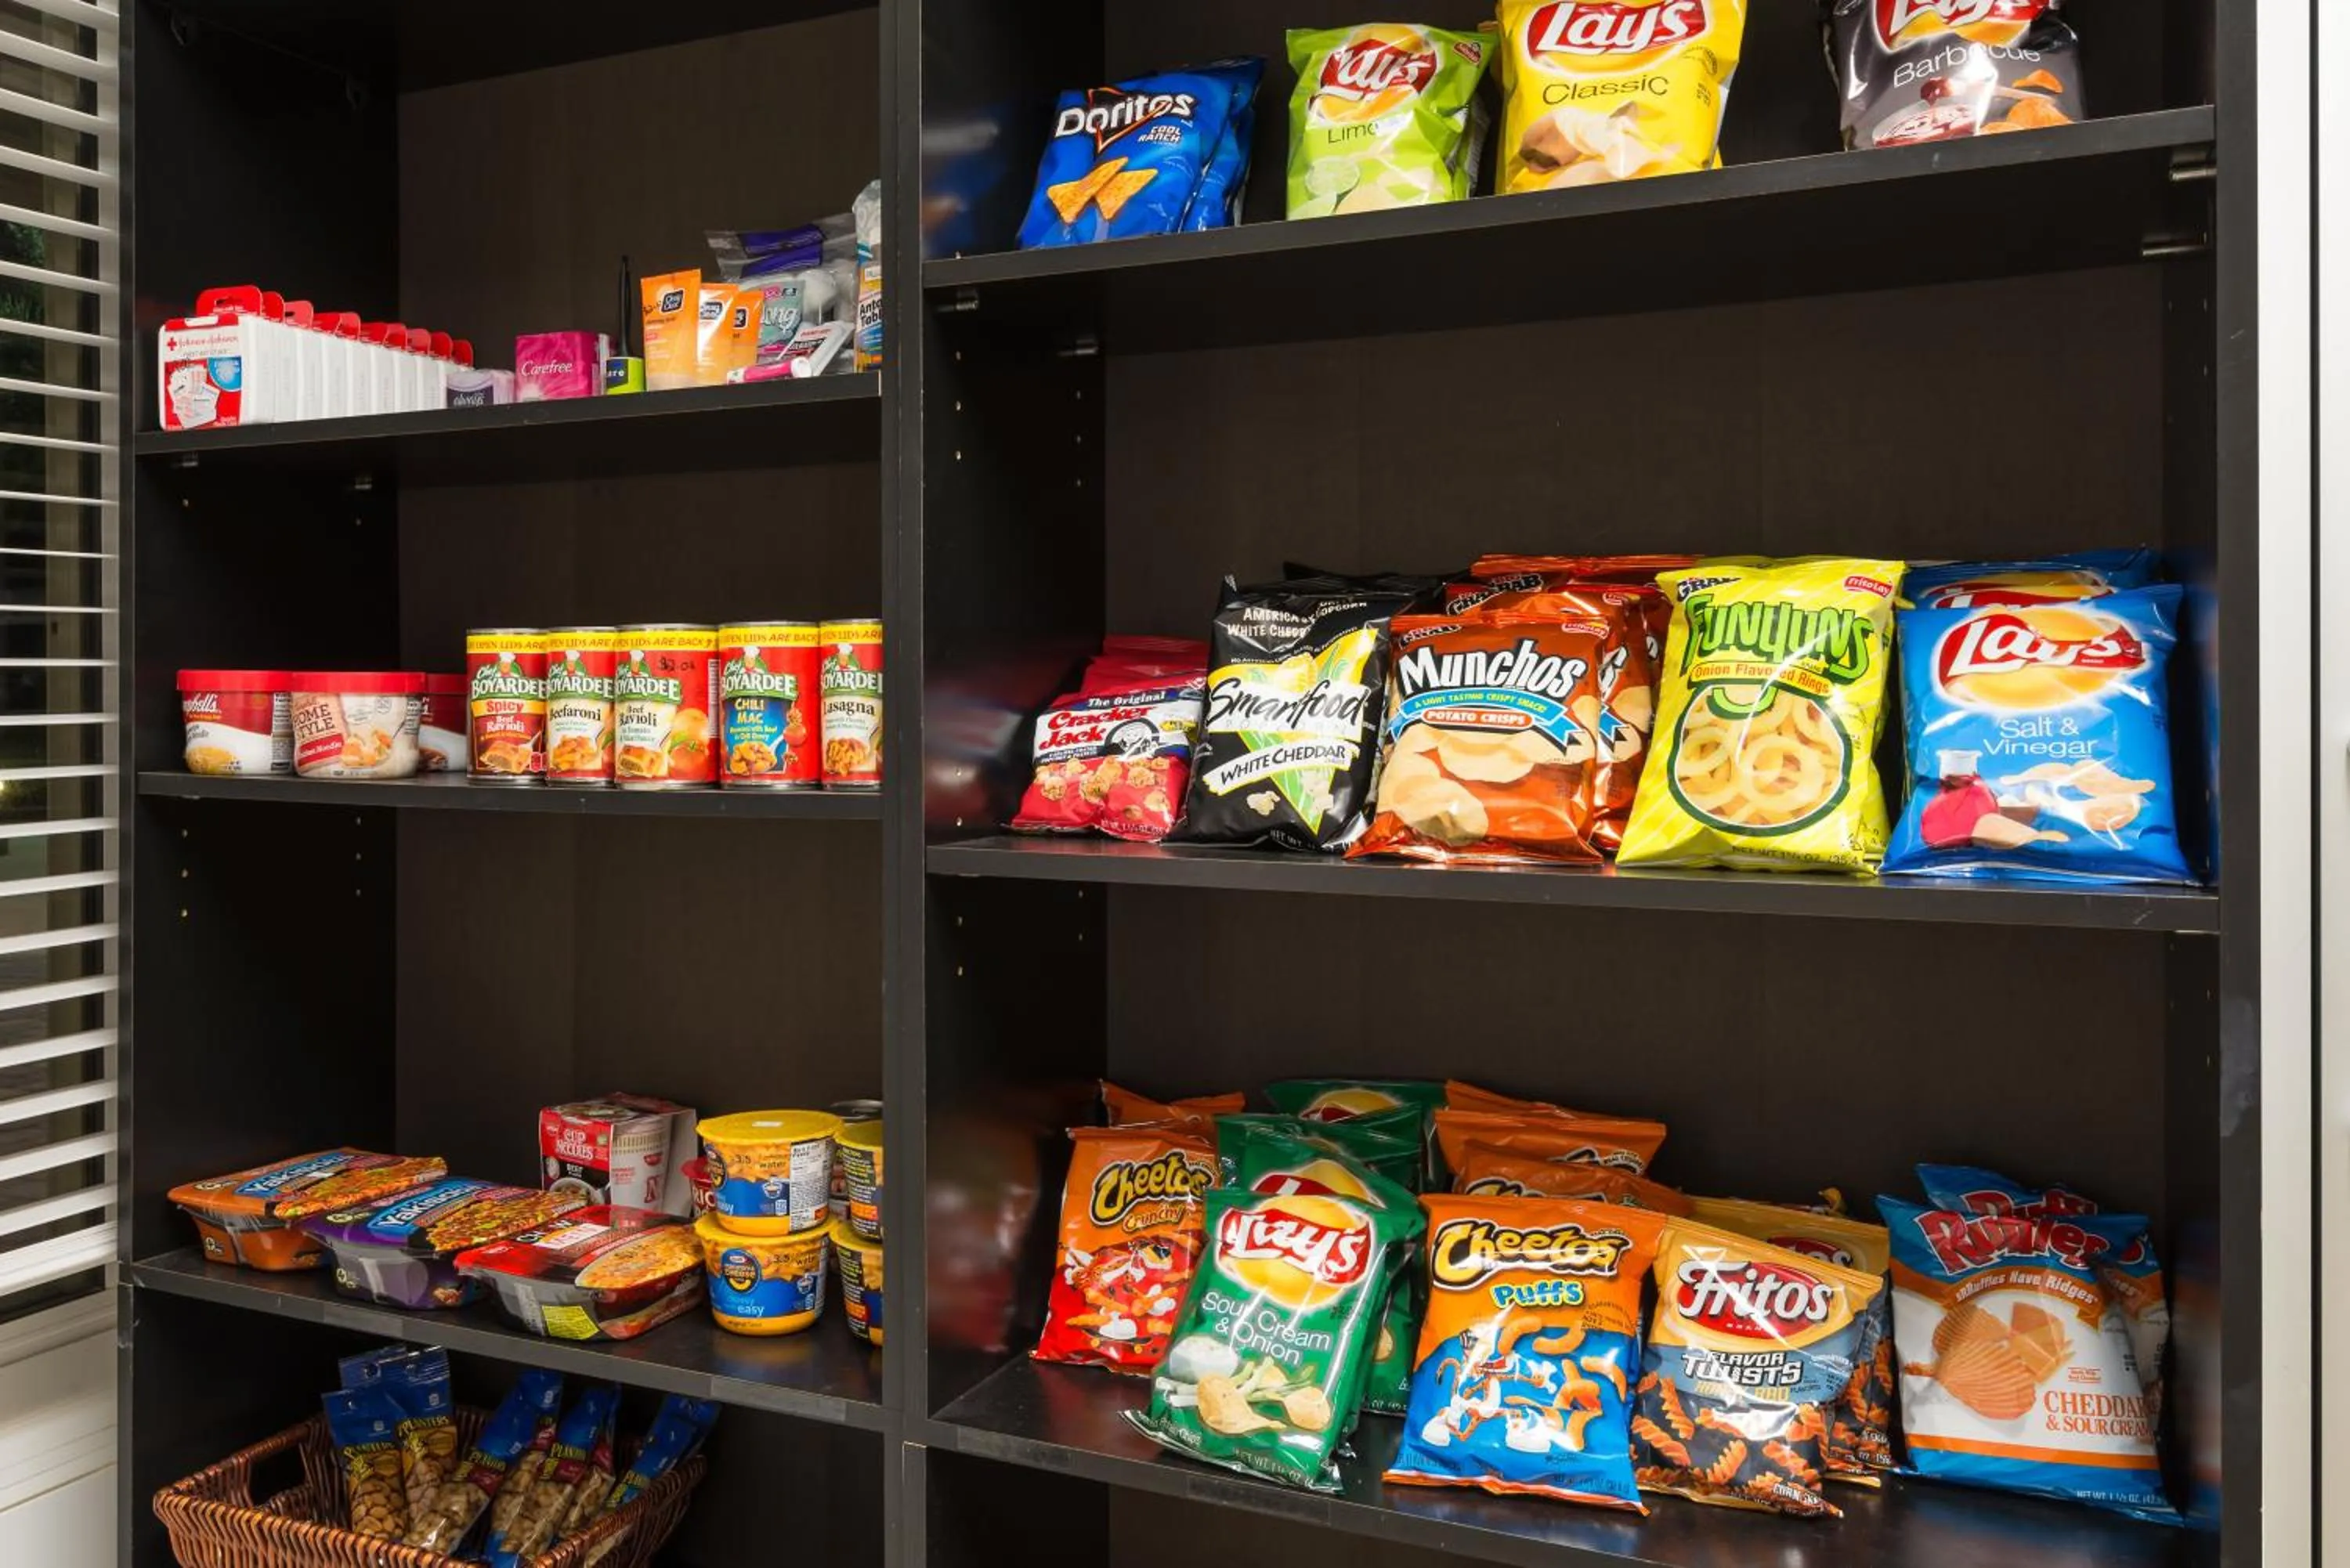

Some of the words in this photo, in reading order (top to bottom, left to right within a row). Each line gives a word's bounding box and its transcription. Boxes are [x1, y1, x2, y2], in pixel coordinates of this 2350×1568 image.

[1893, 42, 2041, 89] Barbcue
[1542, 76, 1668, 106] Classic
[1055, 94, 1195, 138] Doritos
[1137, 132, 1181, 143] RANCH
[1151, 125, 1182, 136] COOL
[521, 359, 573, 377] Carefree
[565, 638, 588, 649] LIDS
[652, 638, 675, 647] ARE
[743, 633, 767, 644] LIDS
[768, 633, 792, 643] ARE
[1399, 639, 1589, 698] Munchos
[1696, 663, 1731, 677] Onion
[1736, 663, 1795, 681] Flavoed
[1798, 671, 1830, 694] Rings
[472, 676, 547, 699] BOYARDEE
[548, 675, 615, 699] OYARDEE
[734, 698, 765, 711] CHILI
[1087, 697, 1112, 708] The
[1113, 691, 1166, 706] Original
[1206, 677, 1371, 730] Smartfood
[1423, 696, 1445, 706] LIGHT
[1449, 693, 1484, 702] TASTING
[1487, 692, 1517, 703] CRISPY
[736, 712, 764, 724] MAC
[1047, 706, 1157, 731] Cracker
[1427, 711, 1477, 722] POTATO
[1480, 714, 1525, 724] CRISPS
[1999, 717, 2054, 739] Salt
[2060, 718, 2080, 735] &
[1039, 725, 1107, 750] Jack
[1983, 738, 2100, 759] Vinegar
[1220, 756, 1271, 785] WHITE
[1271, 745, 1346, 764] CHEDDAR
[1094, 1154, 1210, 1220] Cheetos
[1123, 1207, 1184, 1231] Crunchy
[1225, 1212, 1366, 1280] Lay's
[1434, 1222, 1628, 1287] Cheetos
[2009, 1270, 2042, 1286] Have
[1495, 1280, 1584, 1307] Puffs
[1677, 1261, 1833, 1321] Fritos
[737, 1305, 765, 1317] easy
[1215, 1317, 1229, 1334] &
[1259, 1310, 1330, 1352] Cream
[1705, 1350, 1785, 1367] FLAVOR
[2045, 1414, 2060, 1431] &
[2063, 1416, 2109, 1436] SOUR
